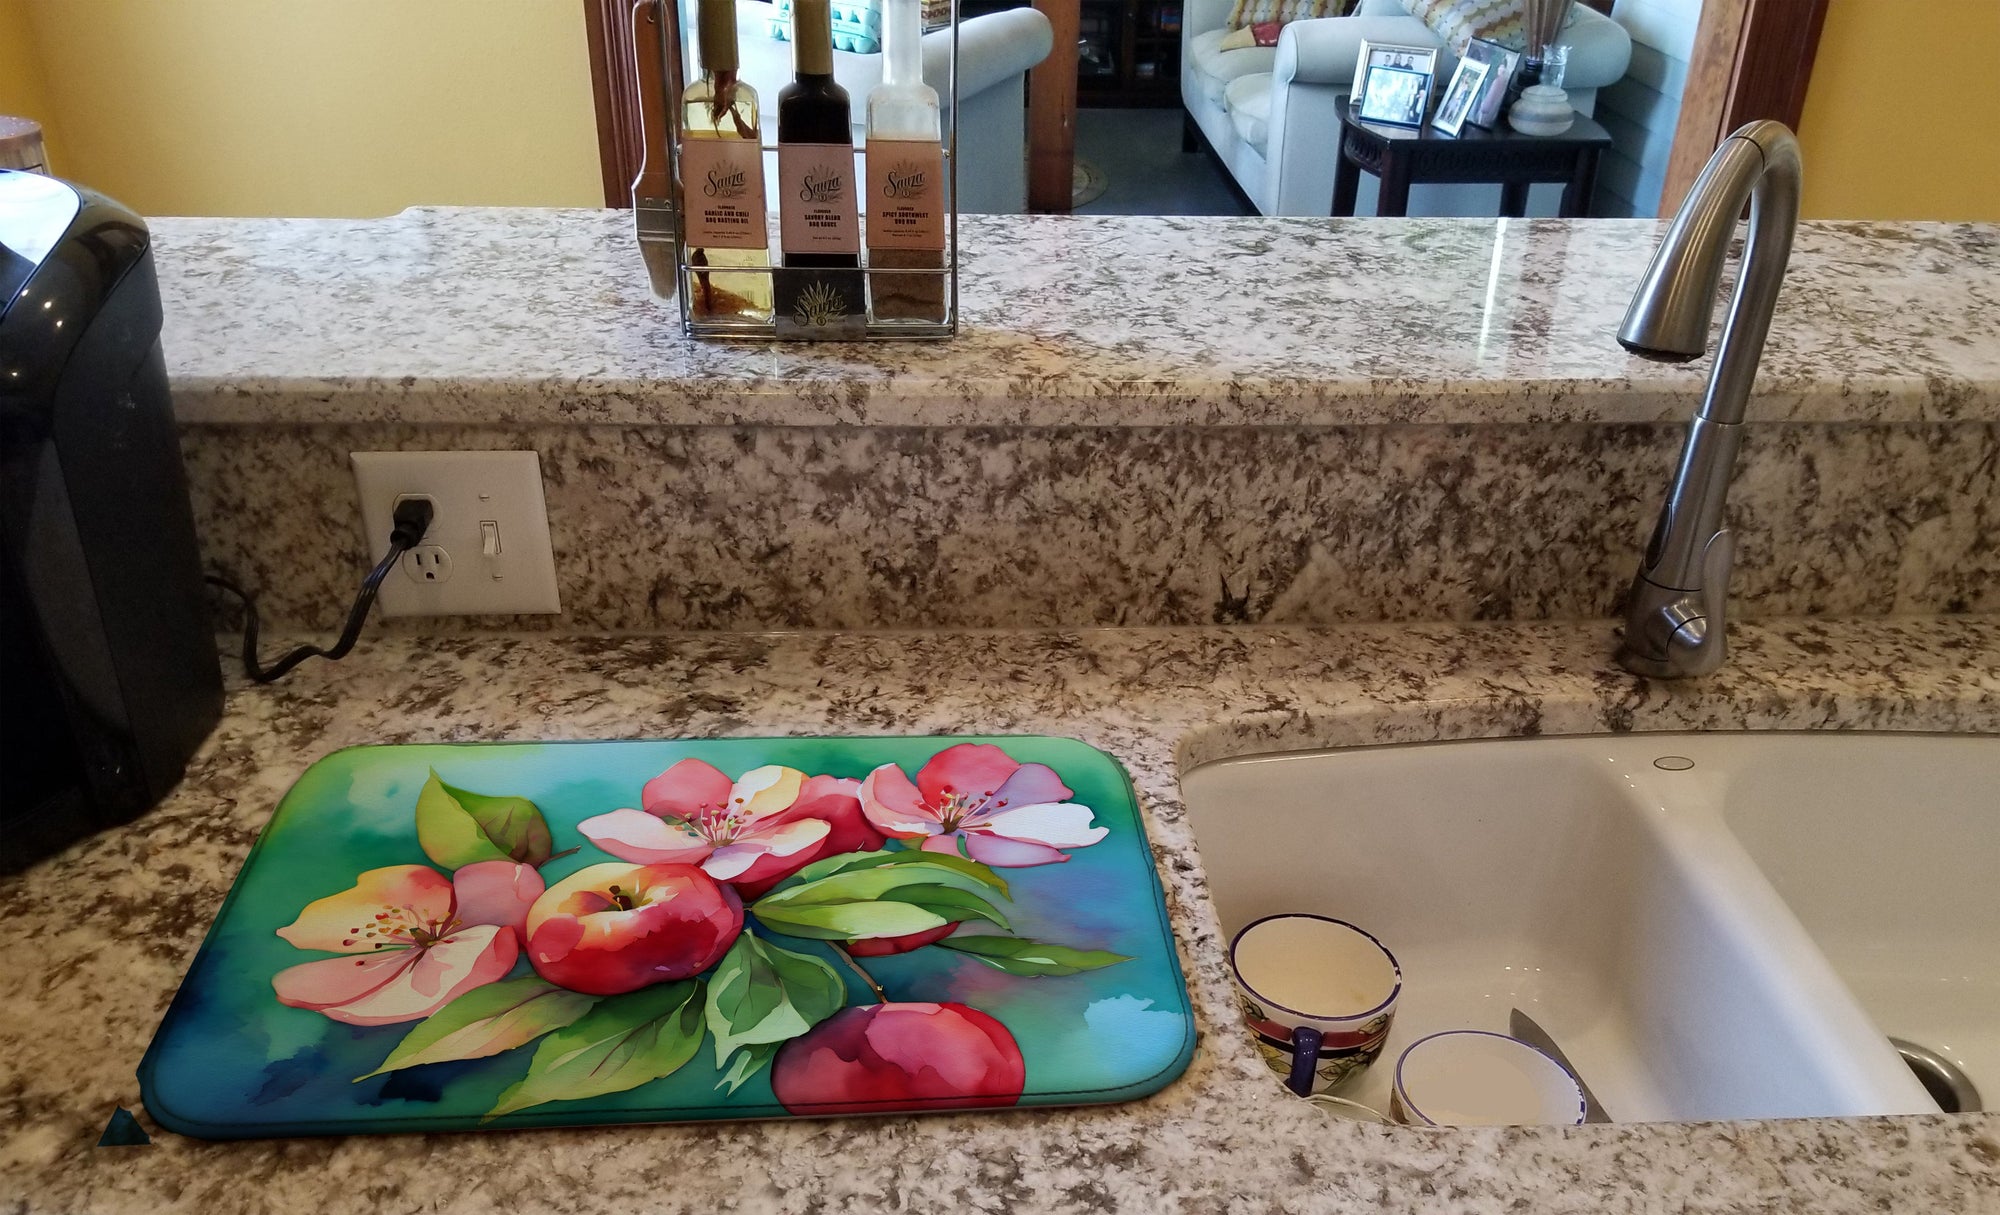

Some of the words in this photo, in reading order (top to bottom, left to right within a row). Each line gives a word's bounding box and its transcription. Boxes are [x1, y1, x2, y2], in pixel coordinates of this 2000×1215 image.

[704, 170, 745, 197] Sauza
[800, 175, 841, 202] Sauza
[884, 171, 924, 198] Sauza
[793, 296, 846, 328] Sauza
